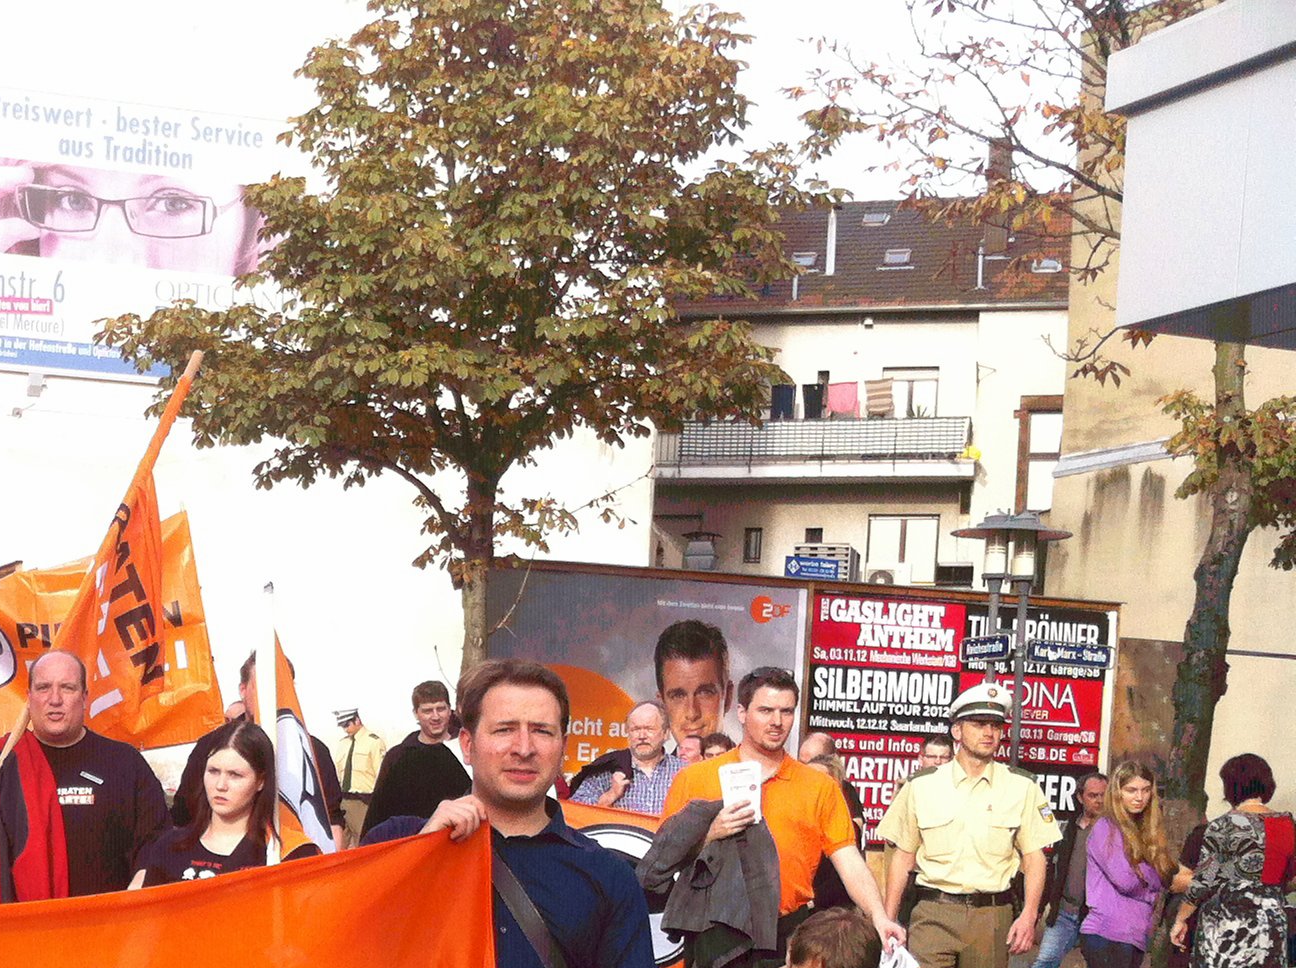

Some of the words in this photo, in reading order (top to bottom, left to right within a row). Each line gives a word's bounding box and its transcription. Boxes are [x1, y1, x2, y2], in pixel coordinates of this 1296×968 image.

[116, 106, 181, 138] bester
[190, 116, 263, 148] Service
[58, 138, 94, 158] aus
[104, 136, 193, 170] Tradition
[53, 270, 65, 303] 6
[13, 313, 65, 336] Mercure)
[820, 598, 830, 622] THE
[830, 598, 945, 628] GASLIGHT
[856, 623, 955, 652] ANTHEM
[829, 647, 867, 662] 03.11.12
[984, 679, 1075, 709] EDINA
[813, 699, 860, 713] HIMMEL
[861, 700, 888, 714] AUF
[888, 702, 922, 716] TOUR
[922, 704, 951, 718] 2012
[566, 716, 603, 736] icht
[609, 722, 630, 738] au
[809, 715, 855, 730] Mittwoch,
[856, 717, 888, 730] 12.12.12
[859, 739, 884, 750] und
[888, 739, 921, 753] Infos
[841, 756, 910, 780] ARTIN
[57, 786, 93, 795] IRATEN
[58, 795, 95, 805] ARTEI
